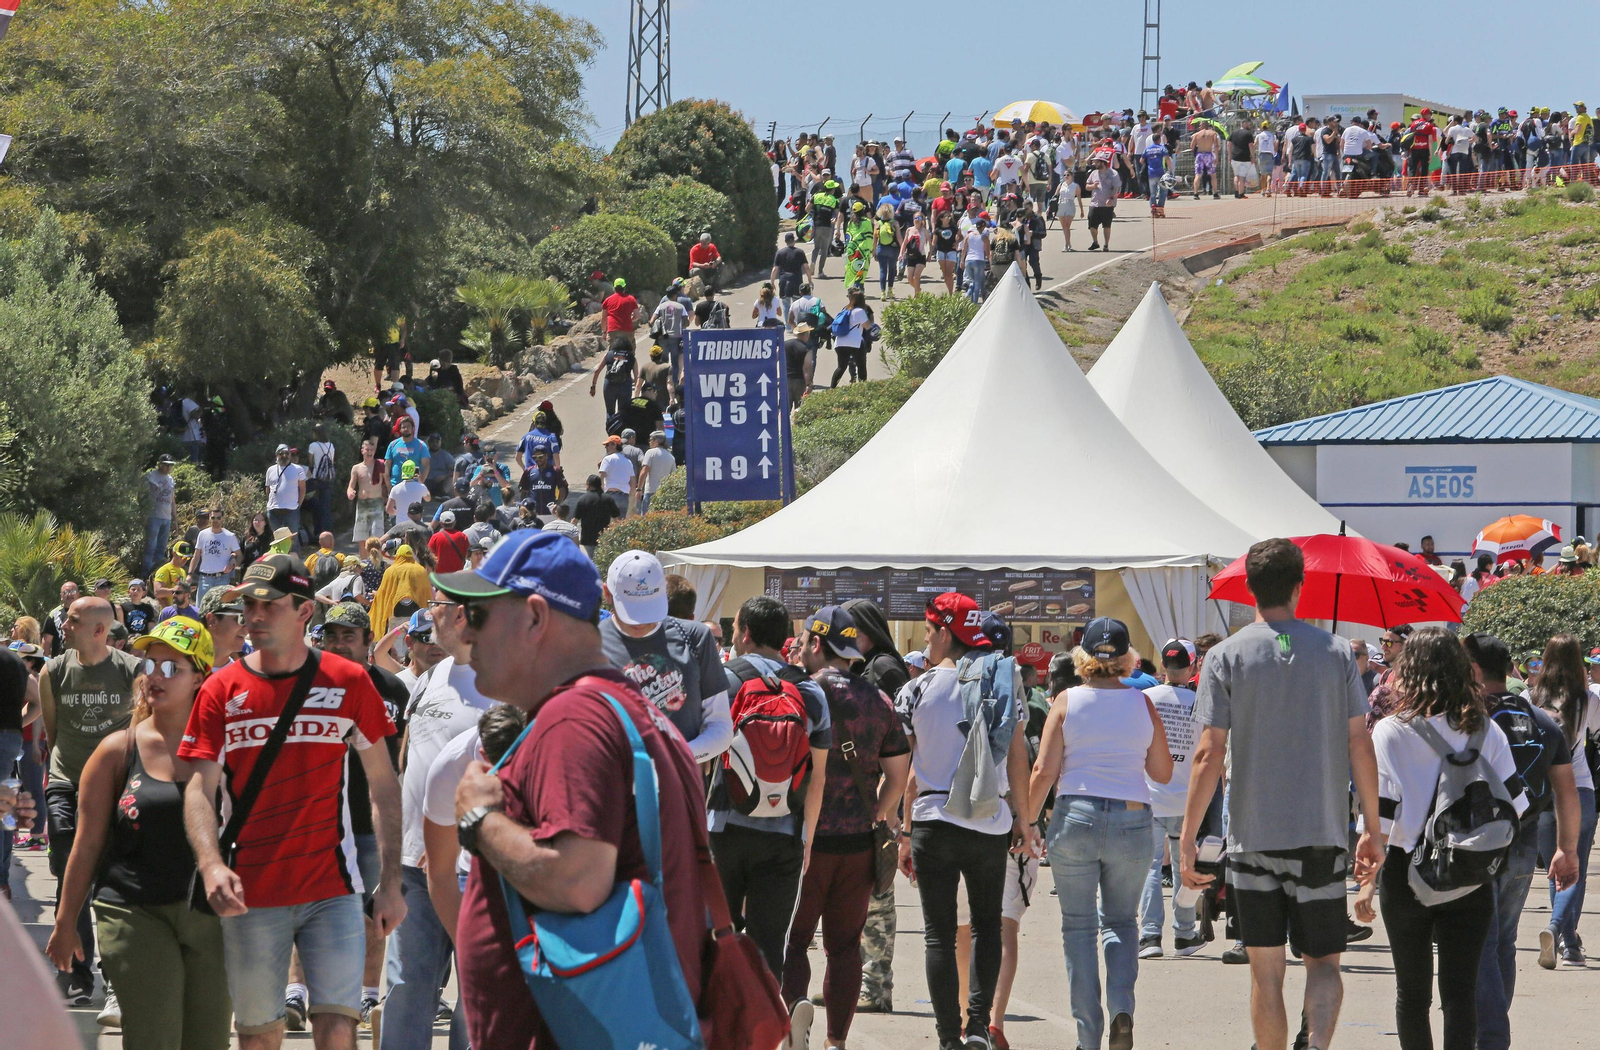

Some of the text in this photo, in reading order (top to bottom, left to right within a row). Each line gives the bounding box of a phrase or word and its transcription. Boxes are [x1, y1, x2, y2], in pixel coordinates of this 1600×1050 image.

[697, 339, 773, 360] TRIBUNAS
[1407, 475, 1474, 498] ASEOS
[1024, 646, 1041, 654] FRIT
[624, 664, 658, 684] The
[641, 670, 683, 699] octor
[61, 690, 121, 708] WAVE RIDING CO
[302, 687, 346, 709] 26
[1170, 753, 1185, 762] 93
